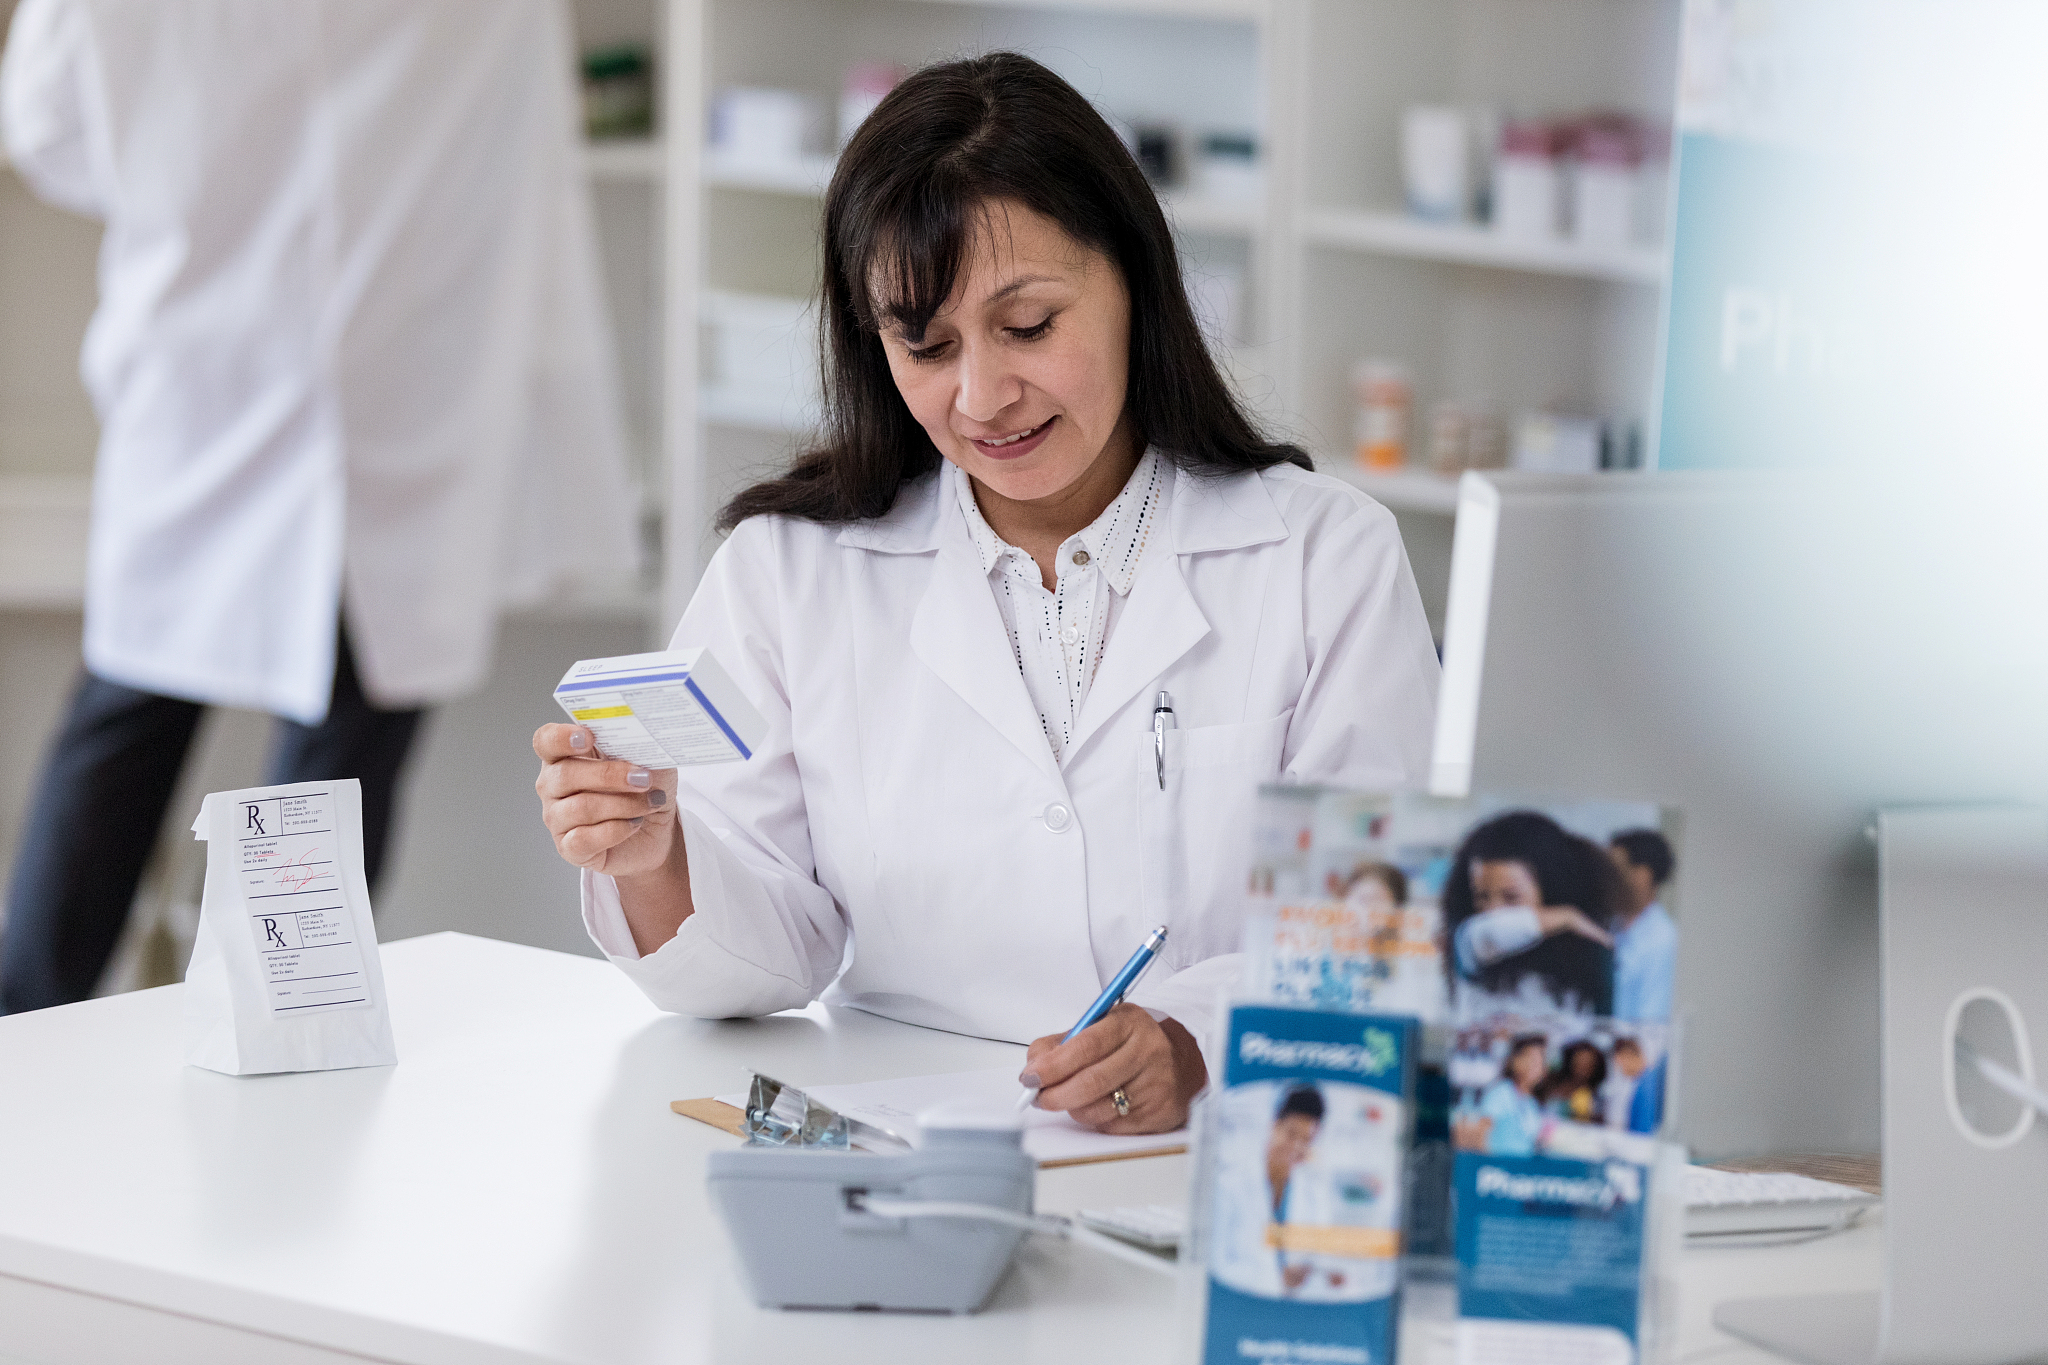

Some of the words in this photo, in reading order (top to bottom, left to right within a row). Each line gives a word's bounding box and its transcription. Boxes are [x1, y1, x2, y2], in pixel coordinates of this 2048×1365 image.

[245, 804, 266, 835] Rx
[261, 918, 287, 947] Rx
[1241, 1032, 1376, 1073] Pharmacy
[1476, 1166, 1618, 1208] Pharmacy
